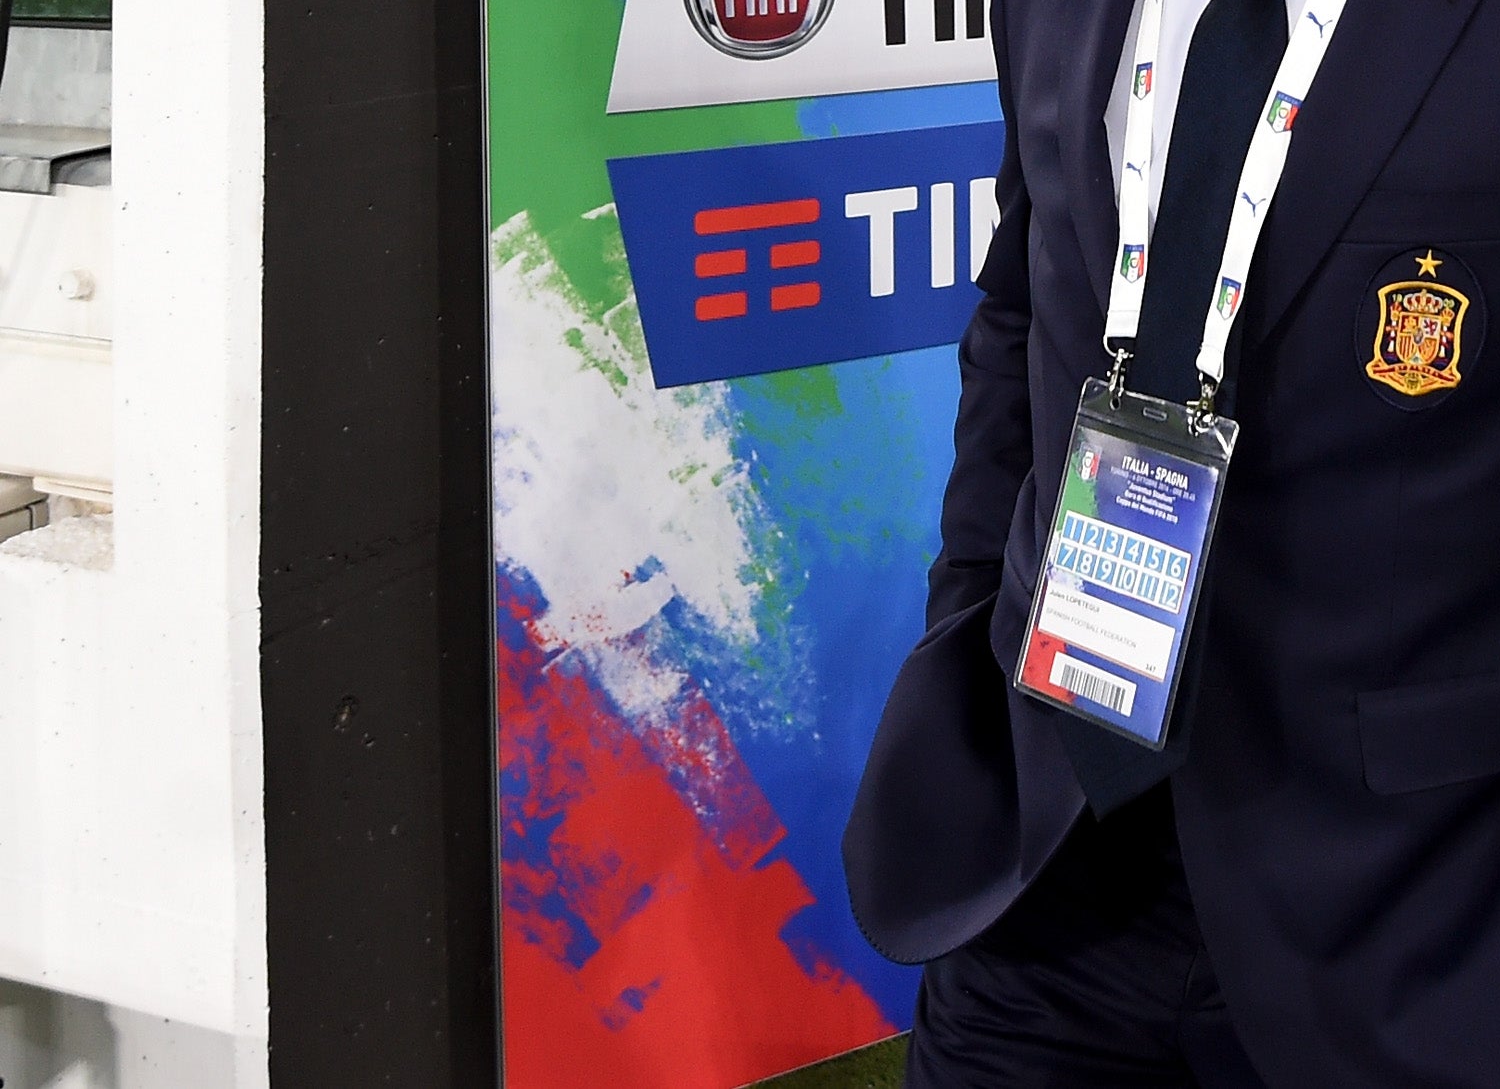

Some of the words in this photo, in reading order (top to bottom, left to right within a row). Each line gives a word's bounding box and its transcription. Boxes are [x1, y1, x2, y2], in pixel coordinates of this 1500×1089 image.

[1122, 455, 1149, 477] ITALIA
[1155, 466, 1188, 490] SPAGNA
[1062, 544, 1074, 567] 7
[1080, 551, 1093, 574] 8
[1100, 558, 1114, 581] 9
[1117, 565, 1136, 591] 10
[1141, 575, 1153, 599] 11
[1161, 582, 1179, 607] 12
[1086, 522, 1100, 547] 2
[1107, 529, 1119, 554] 3
[1128, 537, 1142, 562] 4
[1148, 545, 1162, 569] 5
[1170, 553, 1183, 578] 6
